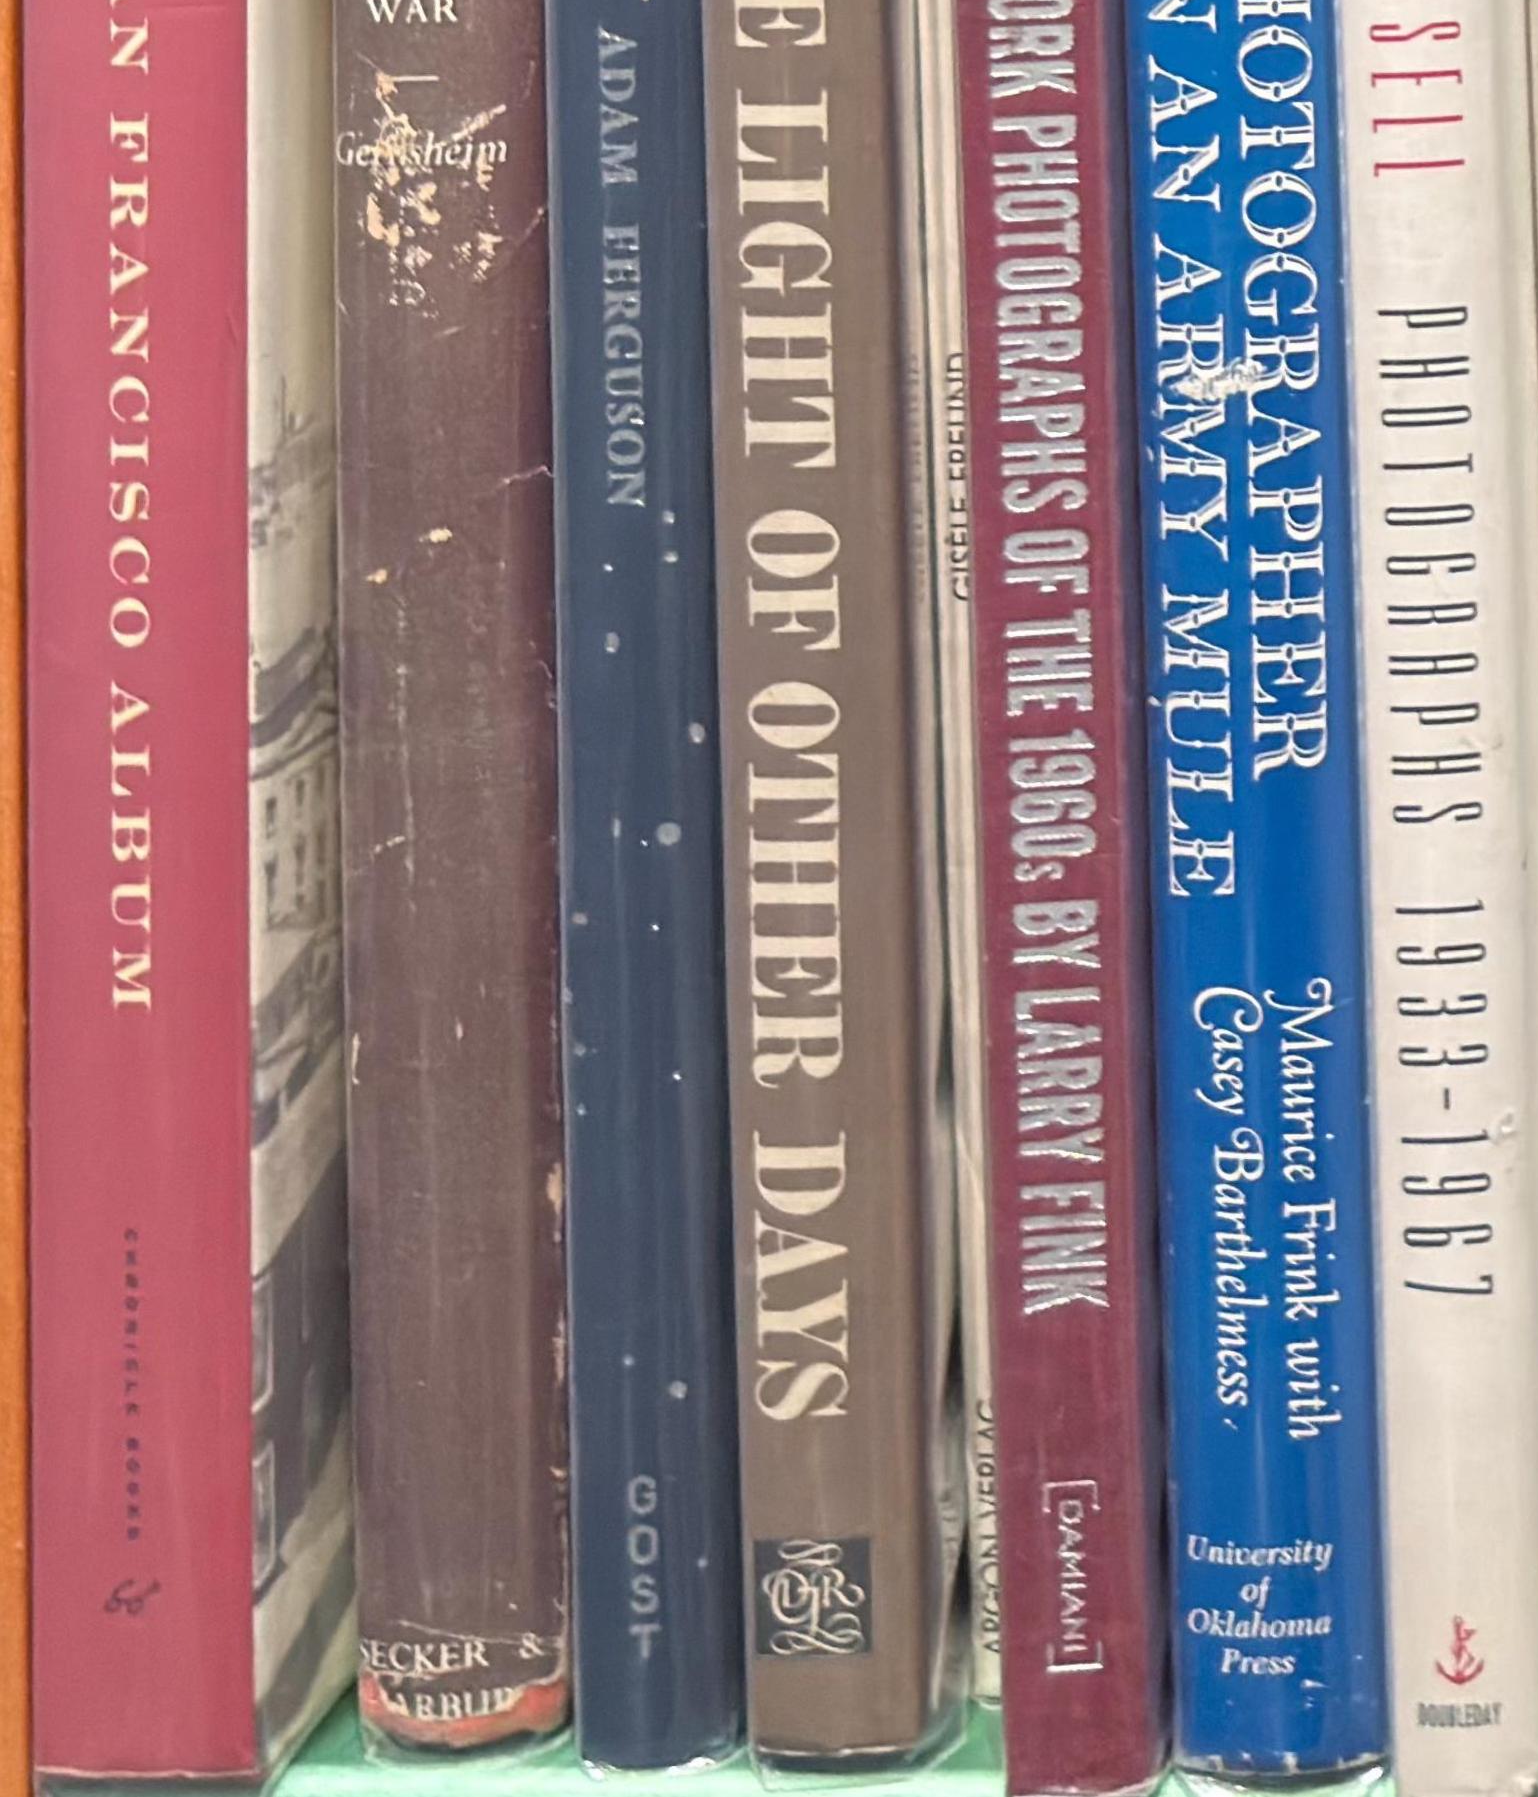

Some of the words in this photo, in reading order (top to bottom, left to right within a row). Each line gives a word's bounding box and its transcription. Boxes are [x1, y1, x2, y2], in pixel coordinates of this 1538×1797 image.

[597, 28, 640, 187] ADAM
[1147, 55, 1220, 209] AN
[736, 88, 837, 468] LIGHT
[993, 113, 1086, 516] PHOTOGRAPHS
[108, 116, 153, 650] FRANCISCO
[601, 223, 648, 506] FERGUSON
[1155, 233, 1228, 560] ARMY
[747, 511, 840, 651] OF
[1002, 529, 1088, 595] OF
[1376, 304, 1483, 826] PHOTOGRAPHS
[1003, 609, 1093, 716] THE
[1008, 727, 1098, 881] 1960s
[1161, 591, 1235, 896] MULE
[109, 682, 152, 1010] ALBUM
[747, 680, 843, 1086] OTHER
[1011, 901, 1100, 965] BY
[1015, 986, 1106, 1165] LARRY
[1193, 984, 1264, 1113] Casey
[1264, 976, 1337, 1183] Maurice
[1393, 898, 1493, 1297] 1933-1967
[755, 1131, 849, 1420] DAYS
[1020, 1182, 1109, 1316] FINK
[1211, 1128, 1267, 1408] Barthelmess
[1281, 1199, 1339, 1324] Frink
[1288, 1339, 1342, 1439] with
[627, 1476, 659, 1658] GOST
[1186, 1535, 1332, 1570] University
[1187, 1608, 1331, 1641] Oklahoma
[1240, 1577, 1271, 1609] of
[519, 1632, 544, 1659] &
[1220, 1648, 1294, 1675] Press
[1418, 1703, 1502, 1727] DOUBLEDAY
